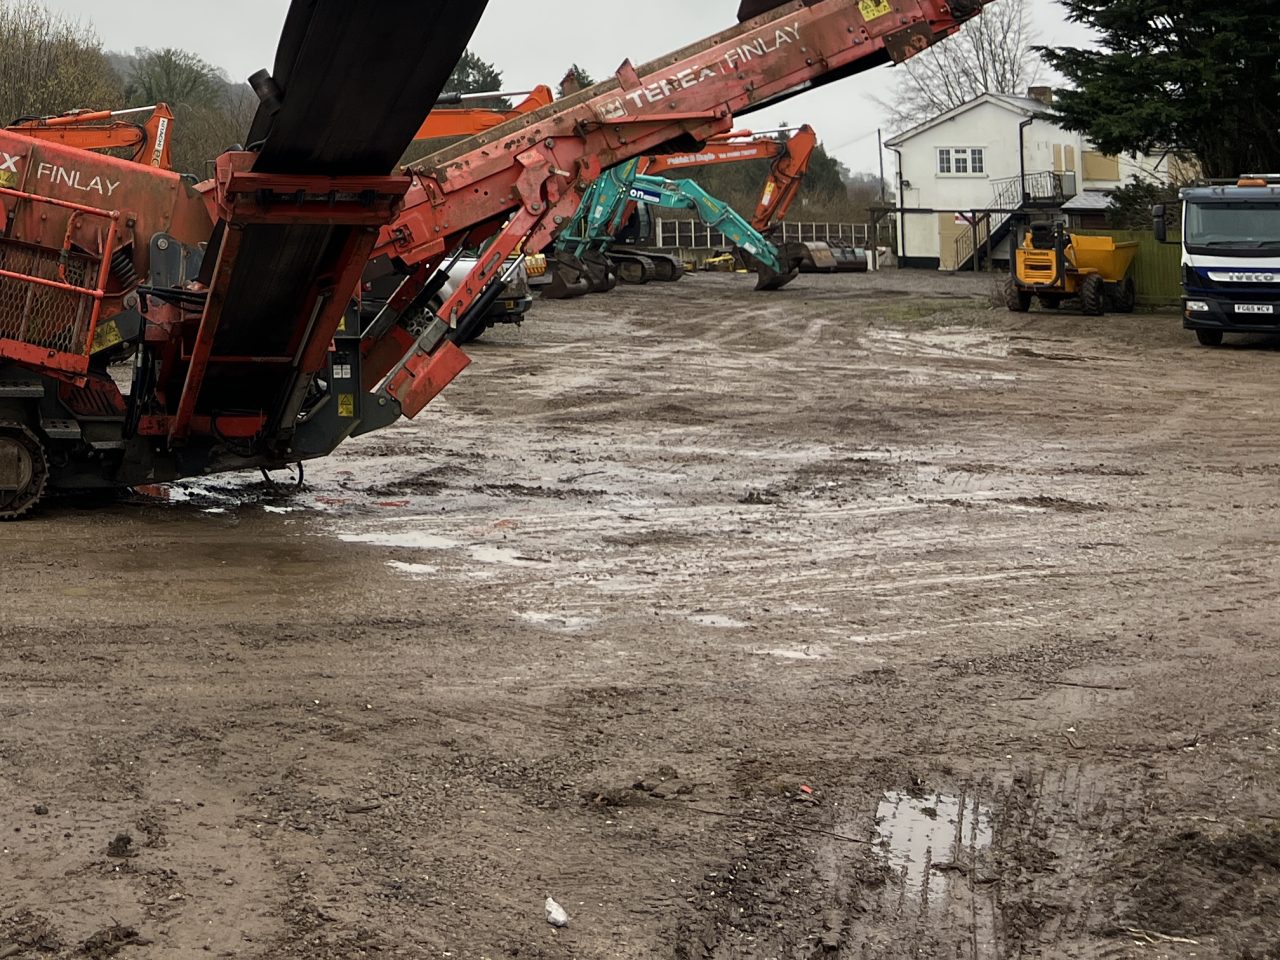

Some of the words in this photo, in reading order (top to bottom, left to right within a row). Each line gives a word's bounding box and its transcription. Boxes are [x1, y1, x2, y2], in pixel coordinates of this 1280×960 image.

[724, 22, 800, 69] FINLAY
[37, 162, 120, 196] FINLAY
[1229, 272, 1274, 282] IVECO
